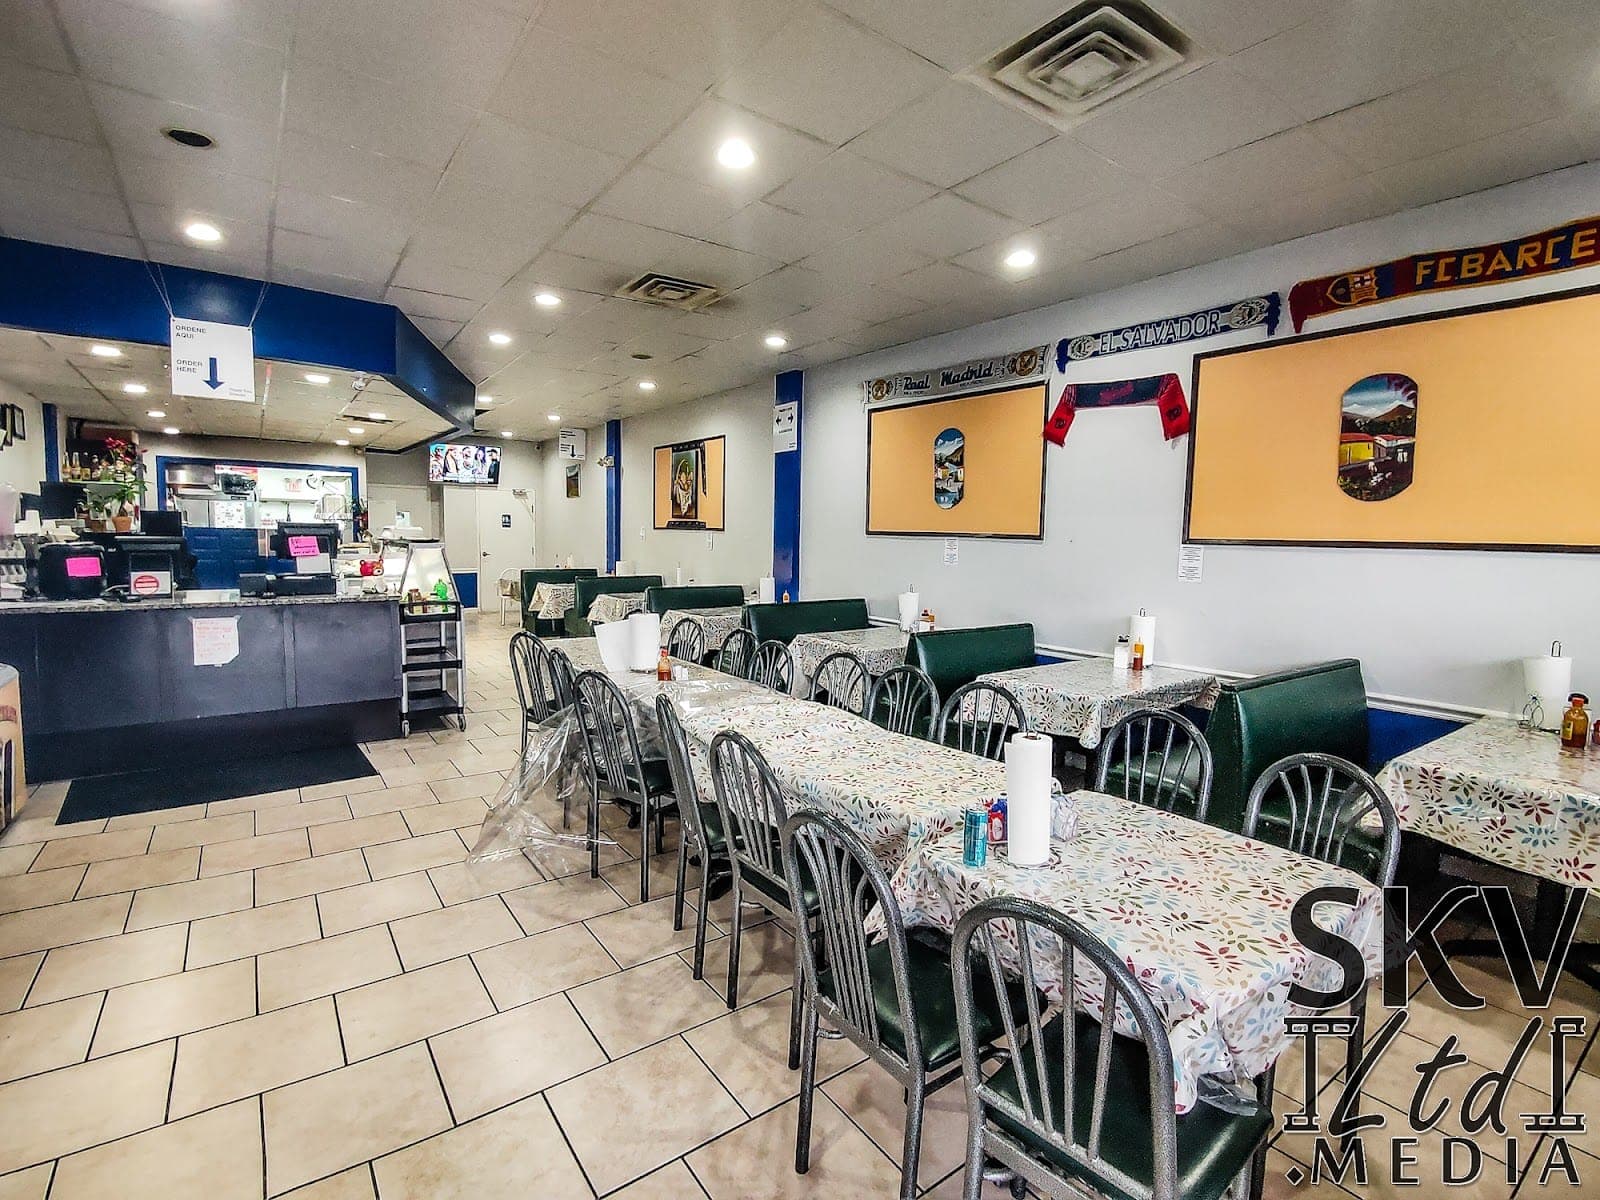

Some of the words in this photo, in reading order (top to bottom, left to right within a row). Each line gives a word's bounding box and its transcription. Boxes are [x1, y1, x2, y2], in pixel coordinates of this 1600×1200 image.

[175, 325, 206, 334] ORDENE
[1099, 332, 1118, 355] EL
[1120, 310, 1221, 349] SALVADOR
[176, 359, 202, 367] ORDER
[940, 361, 994, 387] Madrid
